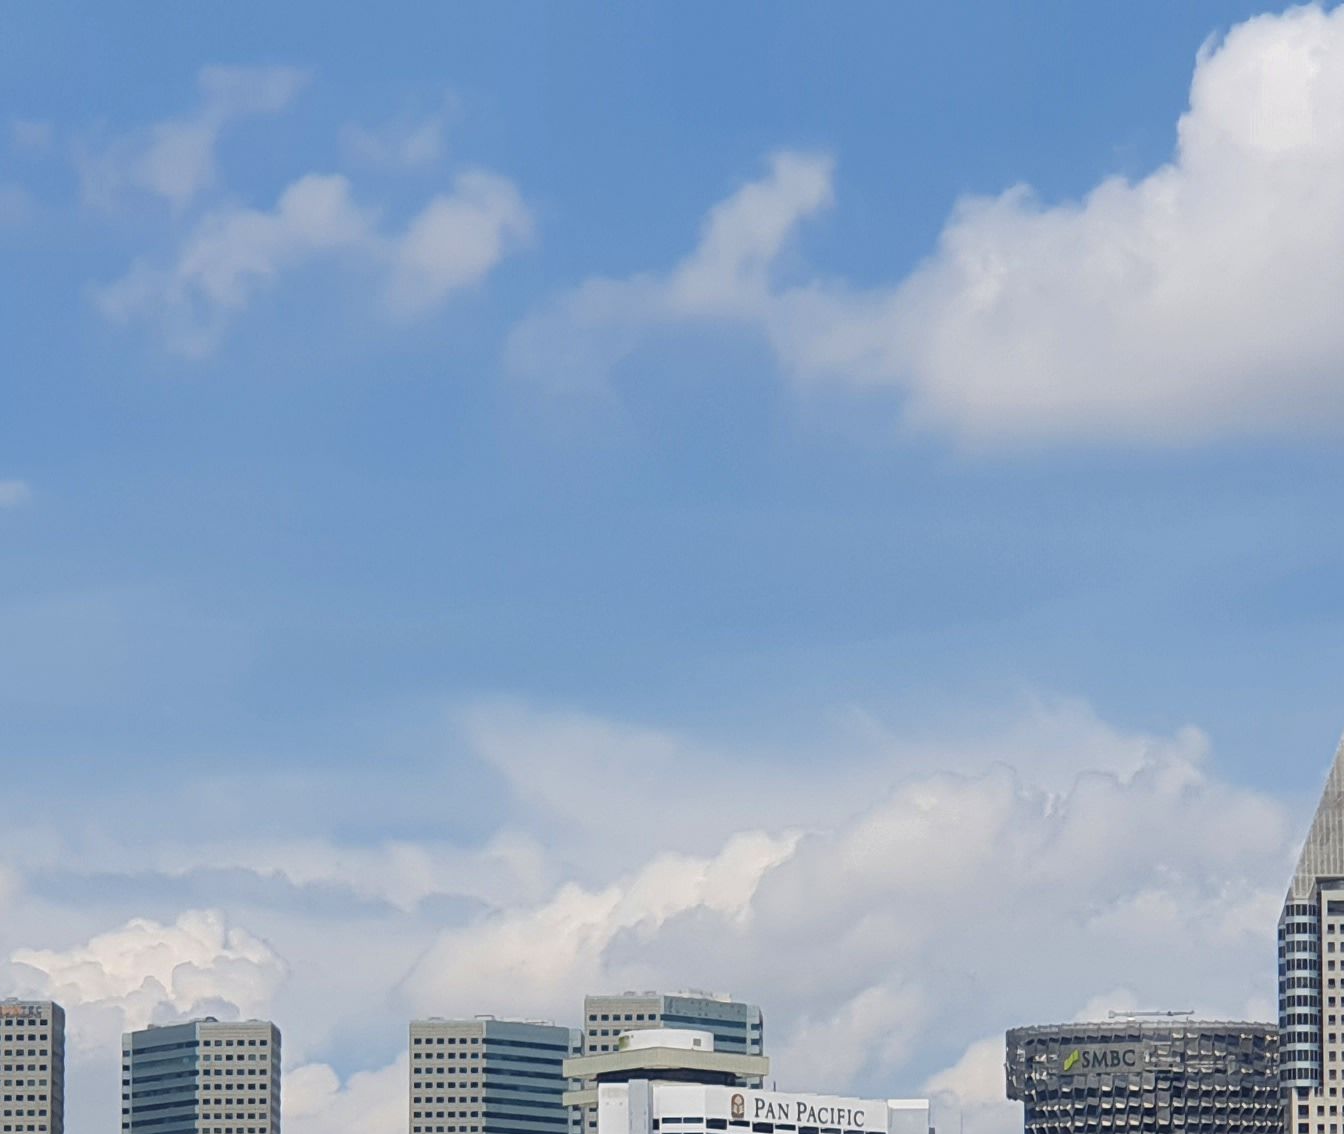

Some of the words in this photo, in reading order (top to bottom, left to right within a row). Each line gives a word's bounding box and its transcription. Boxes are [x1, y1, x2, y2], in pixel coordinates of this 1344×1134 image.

[1081, 1049, 1136, 1069] SMBC
[754, 1097, 790, 1120] PAN
[796, 1101, 865, 1128] PACIFIC
